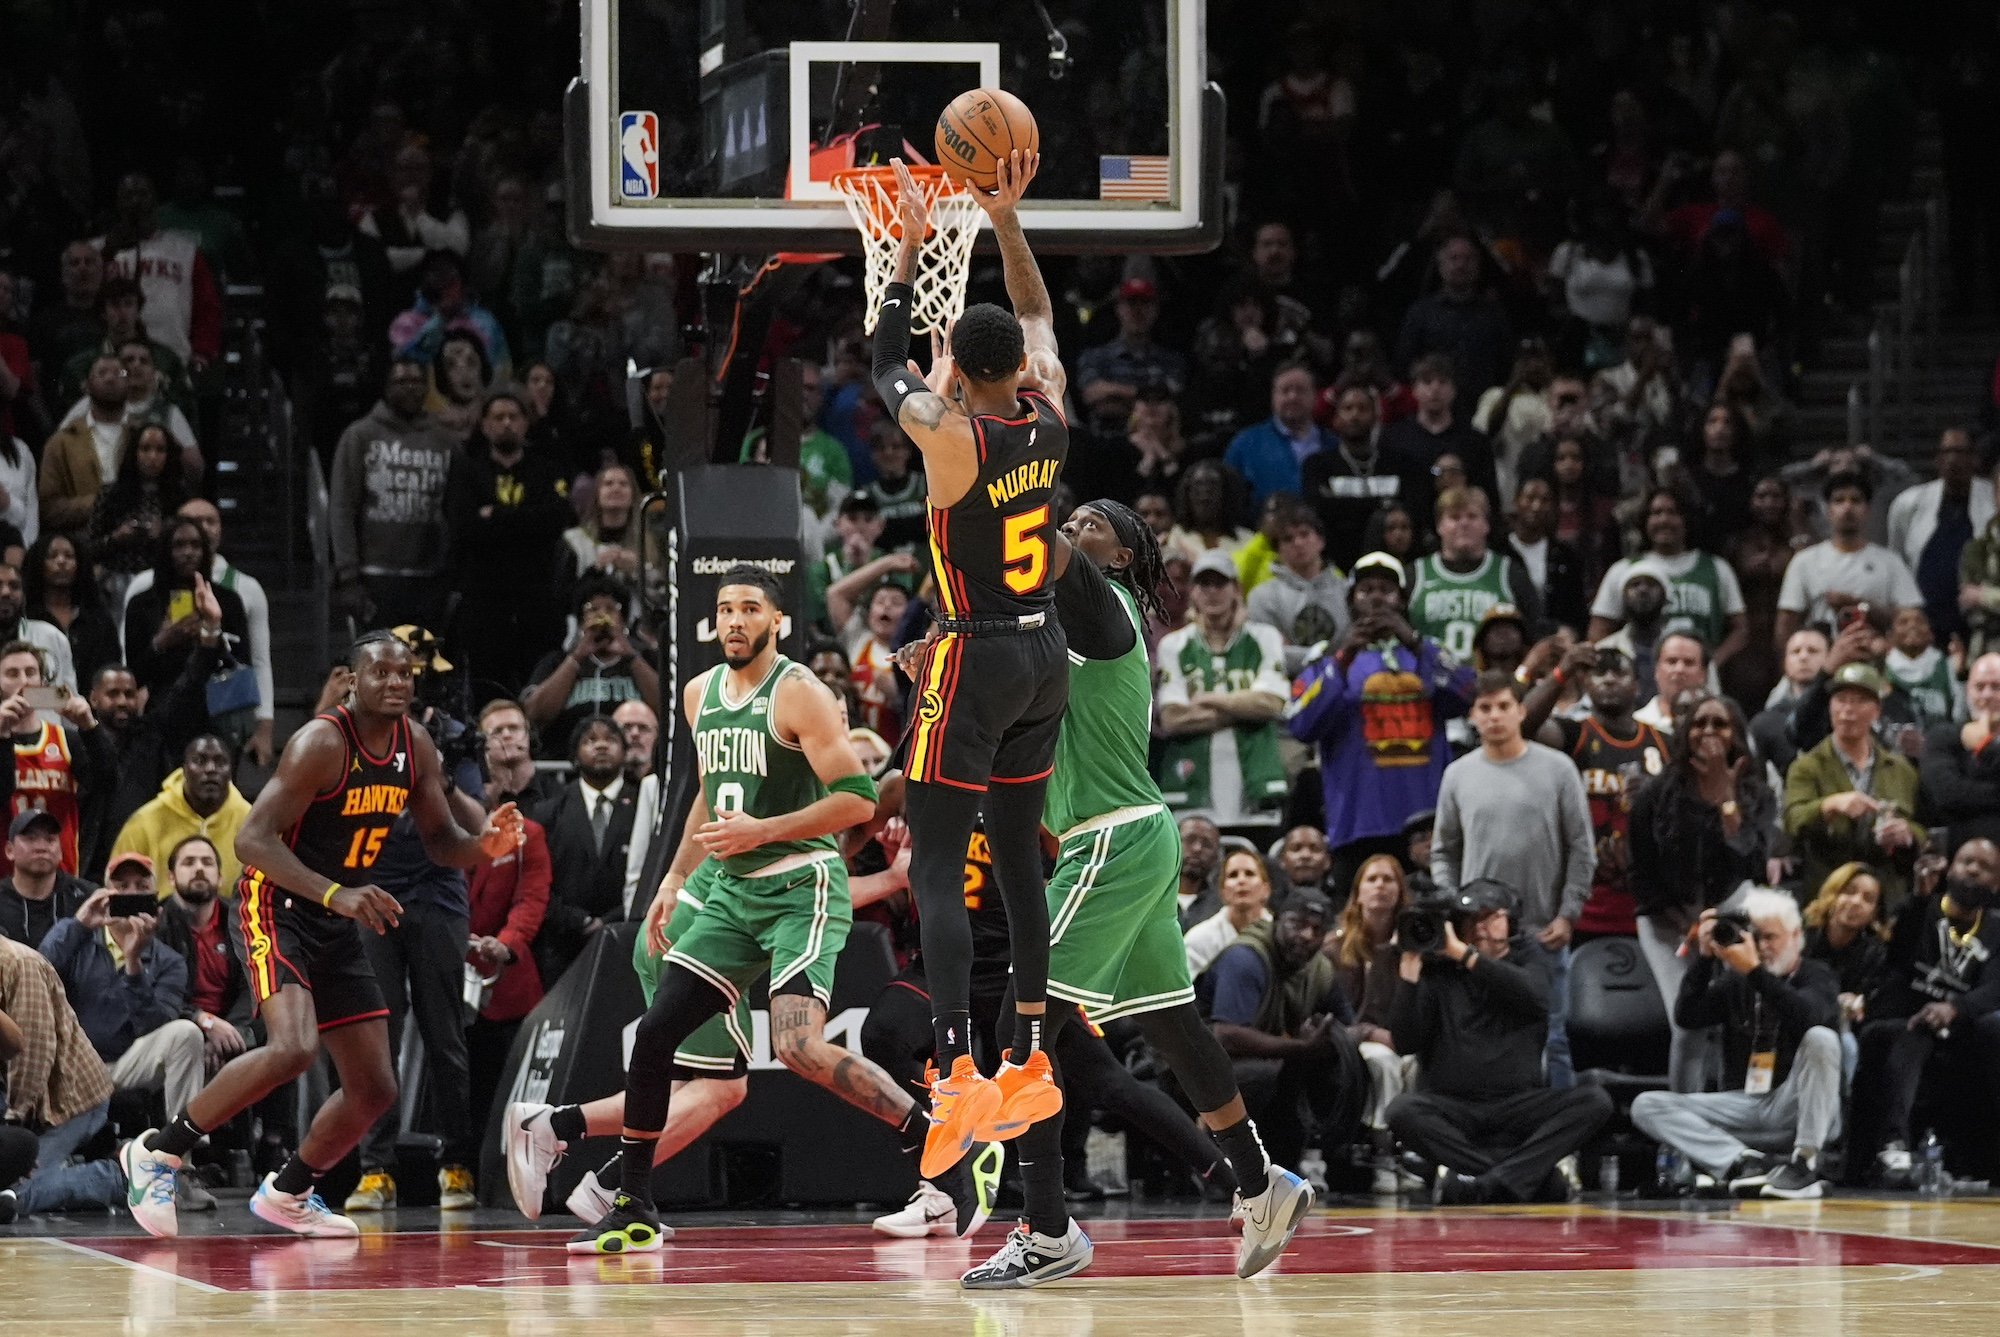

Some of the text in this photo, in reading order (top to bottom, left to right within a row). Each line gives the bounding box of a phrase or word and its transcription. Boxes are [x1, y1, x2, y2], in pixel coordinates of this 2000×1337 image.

[625, 179, 645, 195] NBA
[986, 458, 1060, 509] MURRAY
[1002, 502, 1049, 596] 5
[1445, 620, 1476, 660] 0
[696, 726, 768, 778] BOSTON
[341, 784, 409, 817] HAWKS
[343, 826, 390, 868] 15
